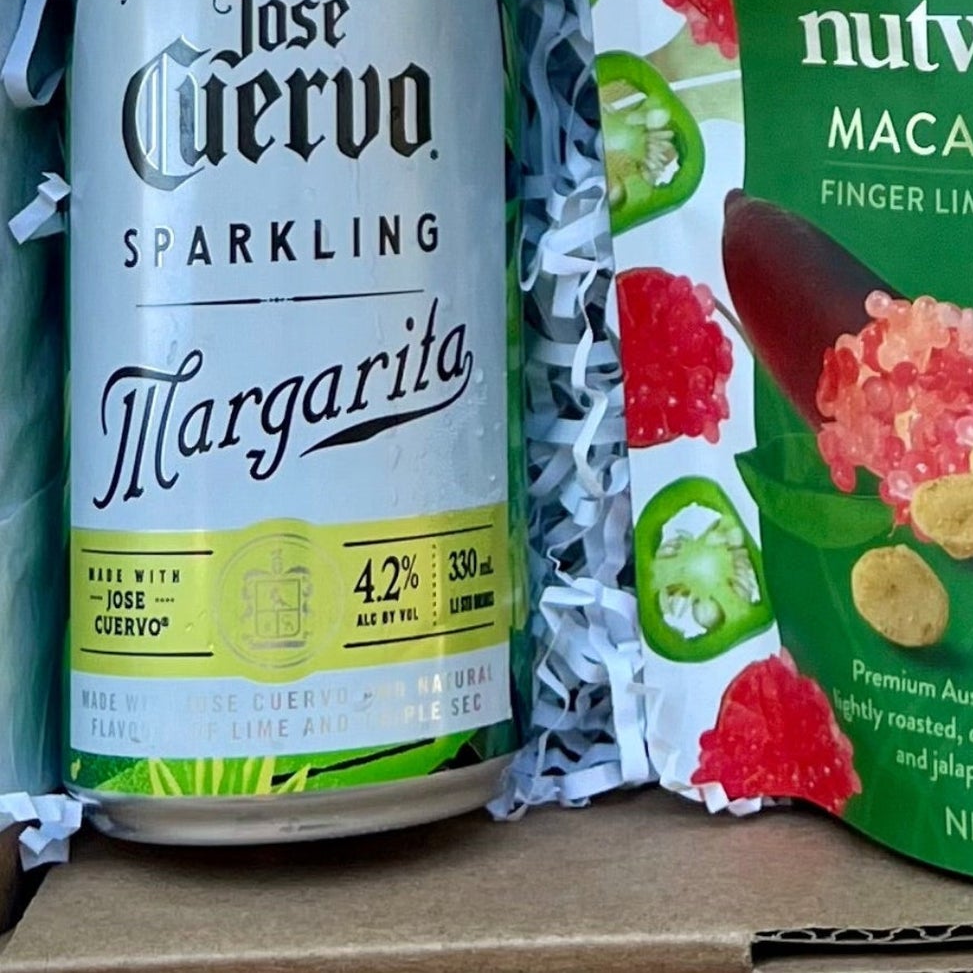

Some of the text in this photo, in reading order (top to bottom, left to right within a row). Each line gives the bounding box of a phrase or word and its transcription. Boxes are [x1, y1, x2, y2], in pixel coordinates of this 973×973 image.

[821, 179, 925, 212] FINGER
[124, 212, 439, 268] SPARKLING
[93, 297, 474, 509] Margarita
[135, 569, 180, 584] WITH
[353, 553, 419, 604] 4.2%
[448, 547, 478, 582] 330
[106, 589, 146, 612] JOSE
[356, 607, 419, 627] ALC BY VOL
[853, 659, 936, 699] Premium
[81, 689, 116, 711] MADE
[253, 687, 348, 712] CUERVO
[233, 718, 288, 740] LIME
[304, 713, 348, 736] AND
[452, 693, 481, 716] SEC
[888, 712, 963, 746] roasted,
[896, 747, 928, 770] and
